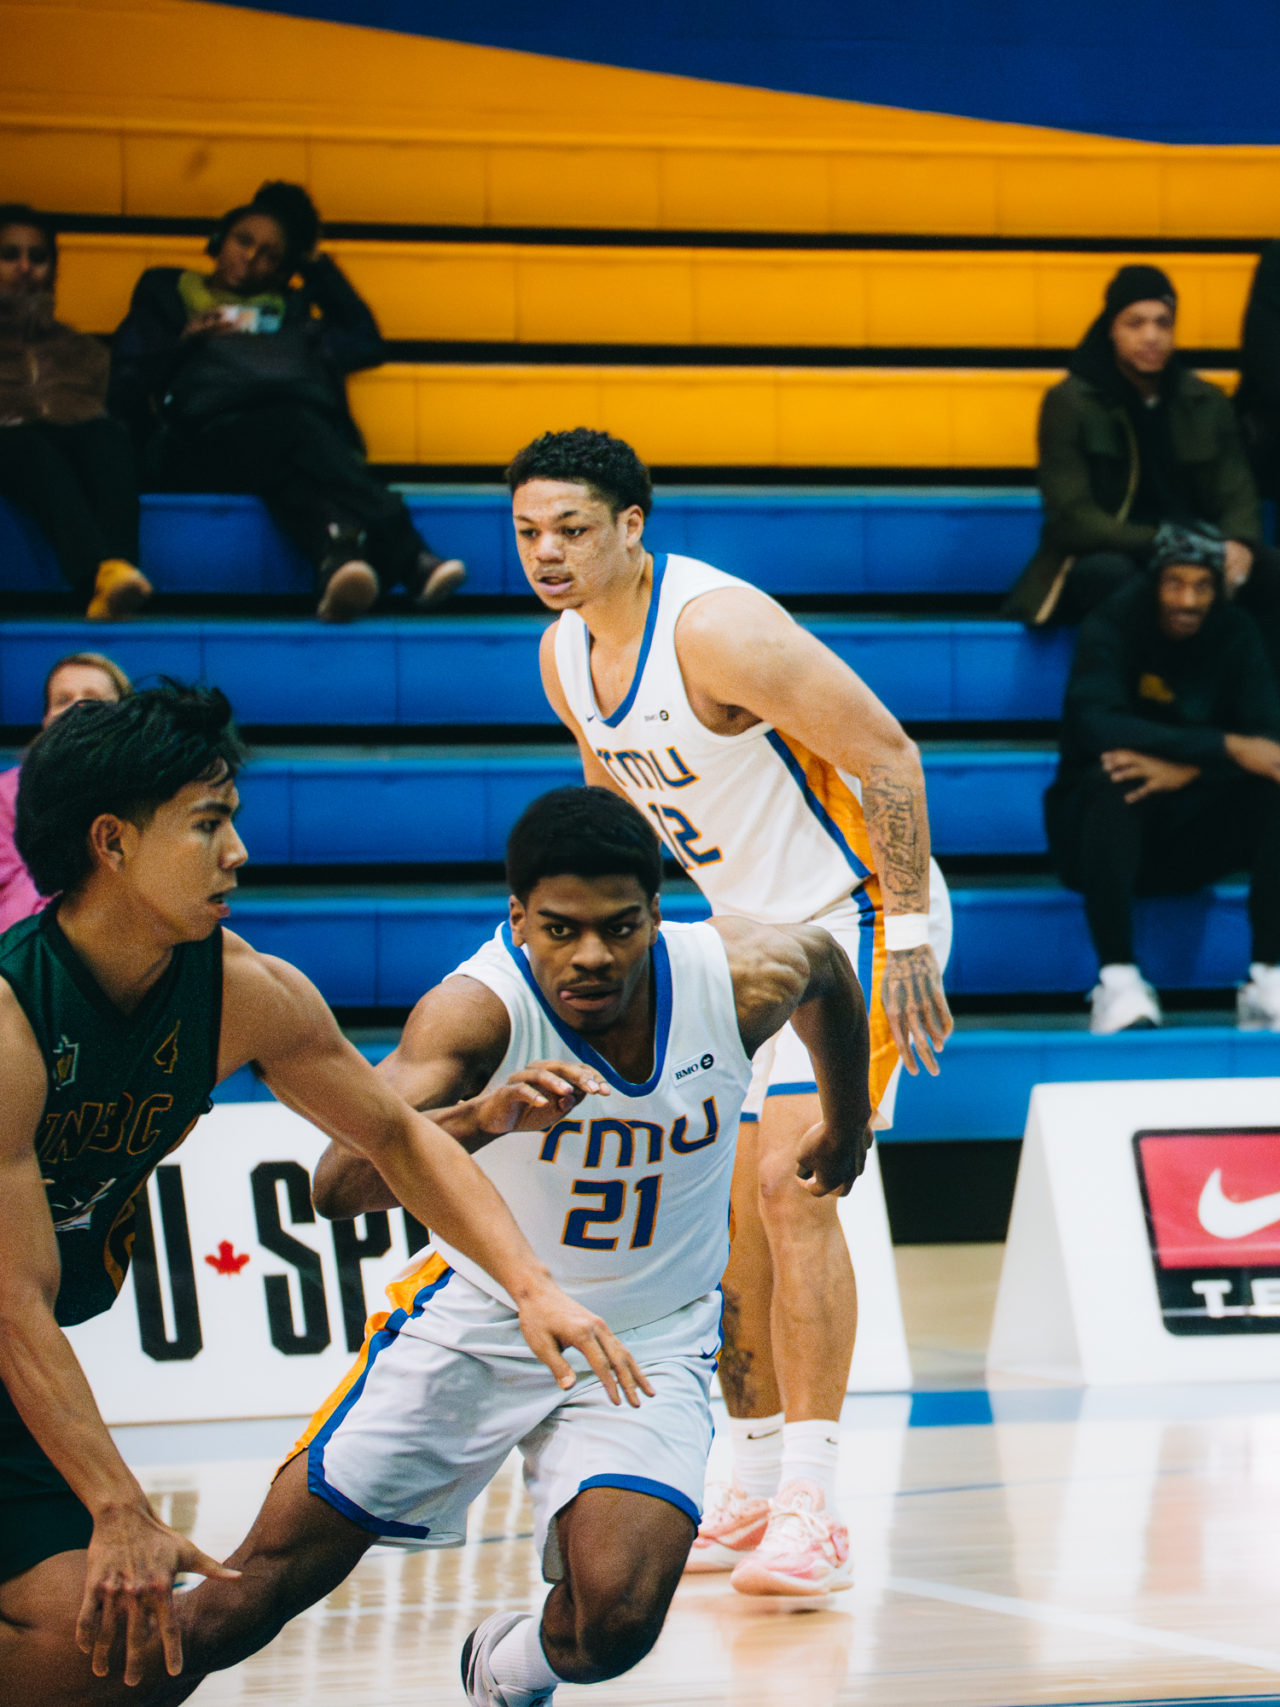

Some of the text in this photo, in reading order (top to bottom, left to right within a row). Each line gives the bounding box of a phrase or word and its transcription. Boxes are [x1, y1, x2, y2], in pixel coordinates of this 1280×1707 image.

[648, 802, 723, 869] 12
[675, 1064, 699, 1080] BMO
[560, 1173, 663, 1251] 21
[250, 1161, 430, 1355] SP
